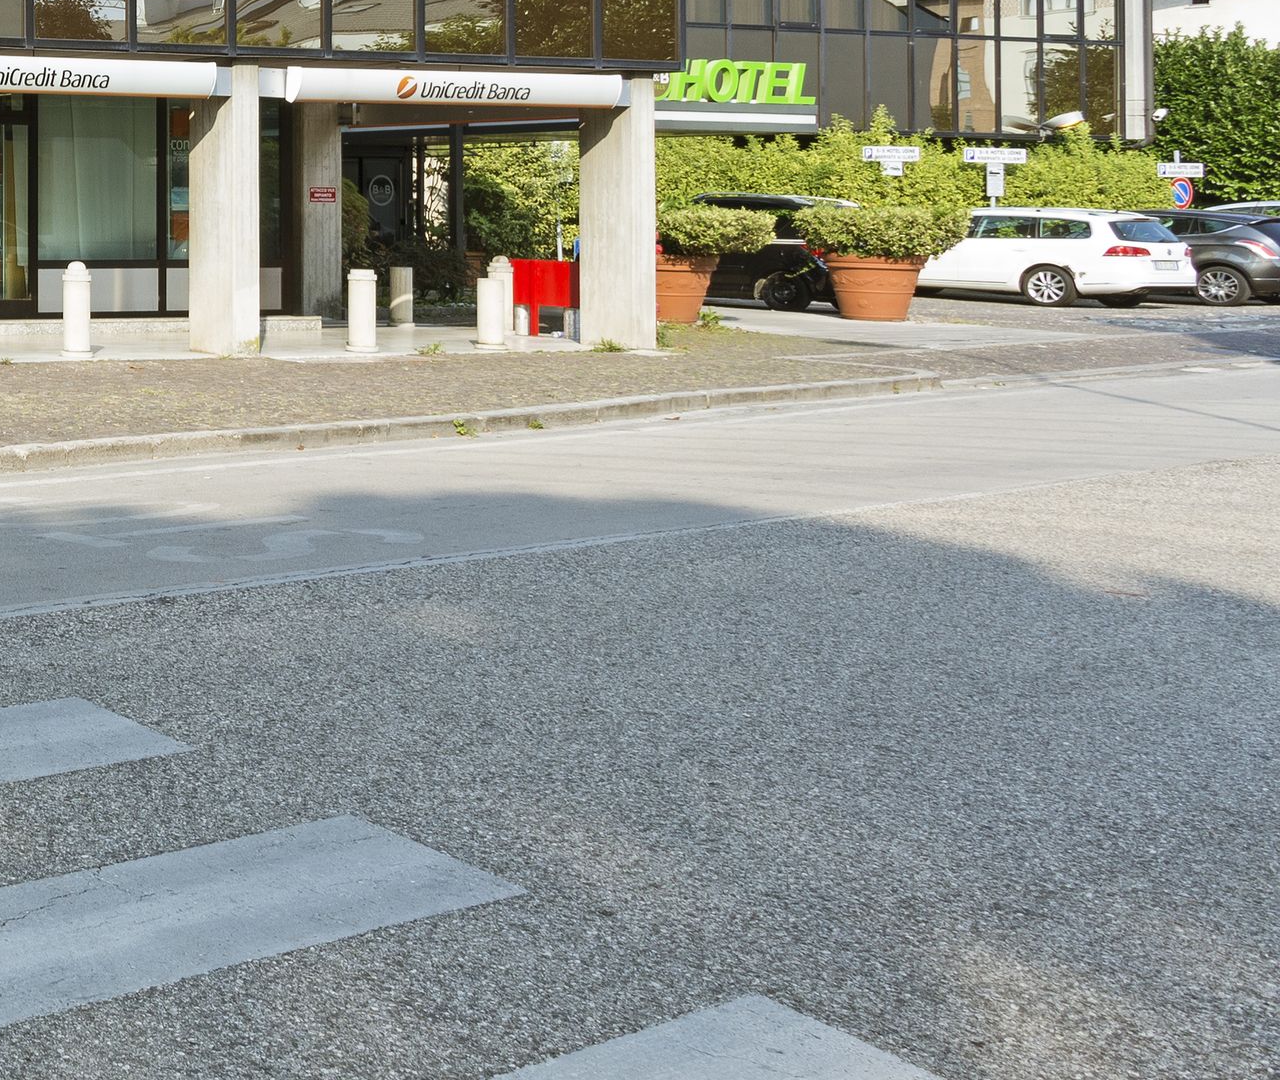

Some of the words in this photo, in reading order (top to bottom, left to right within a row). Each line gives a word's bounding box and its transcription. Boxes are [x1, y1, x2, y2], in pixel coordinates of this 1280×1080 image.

[60, 70, 110, 89] Banca
[652, 73, 669, 83] &B
[668, 59, 817, 105] HOTEL
[420, 80, 486, 100] UniCredit
[488, 82, 531, 101] Banca
